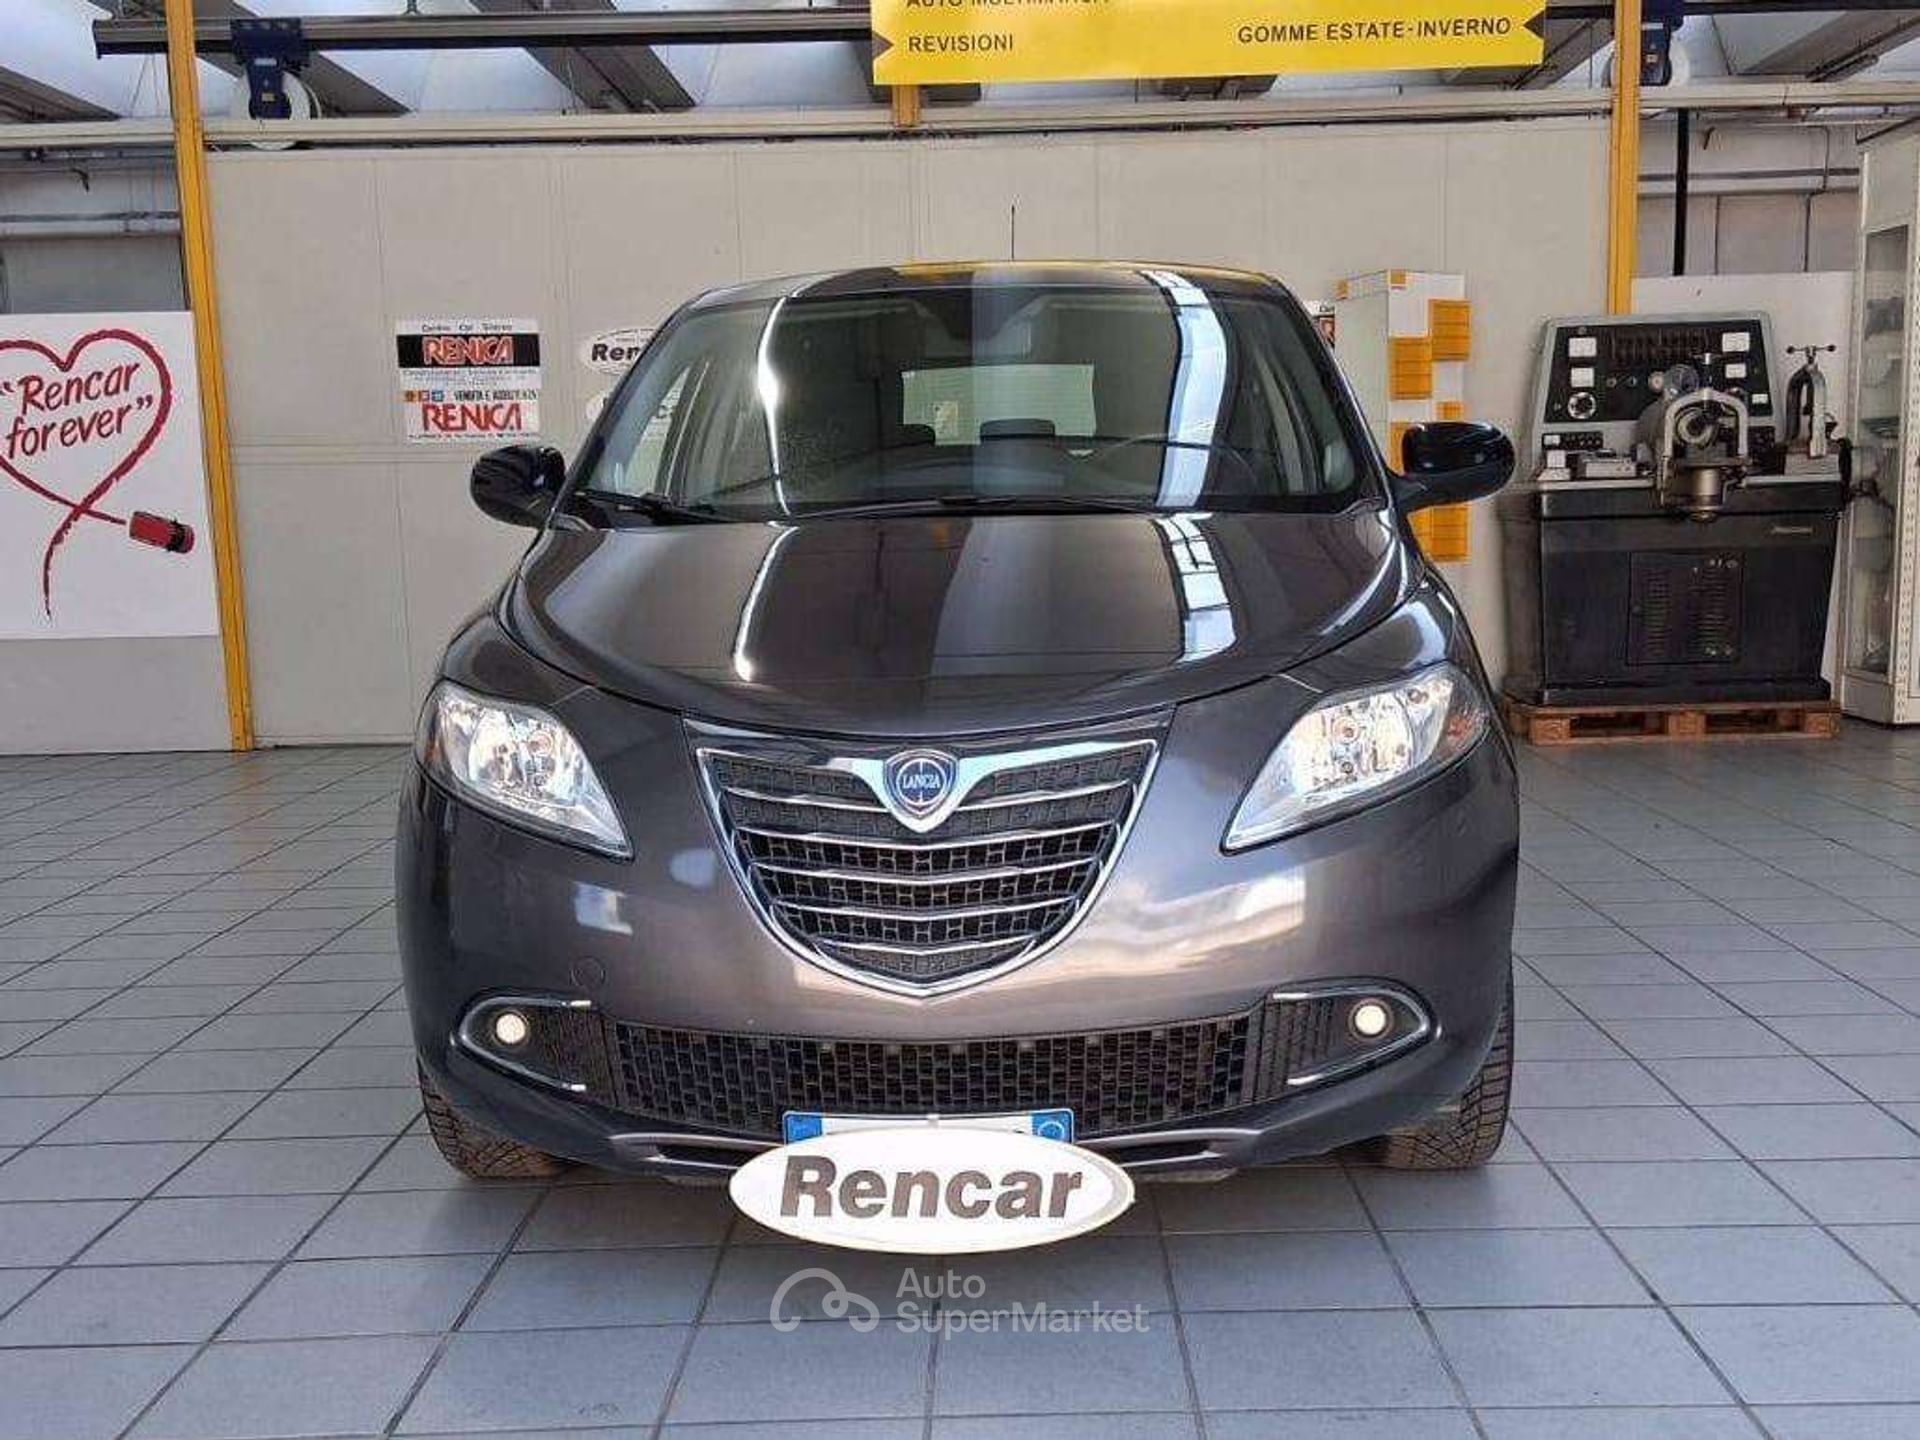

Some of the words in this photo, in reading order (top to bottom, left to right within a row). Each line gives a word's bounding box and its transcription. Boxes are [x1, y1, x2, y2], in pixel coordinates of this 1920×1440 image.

[908, 34, 1013, 52] REVISIONI
[1238, 24, 1318, 43] GOMME
[780, 1154, 1083, 1219] Rencar
